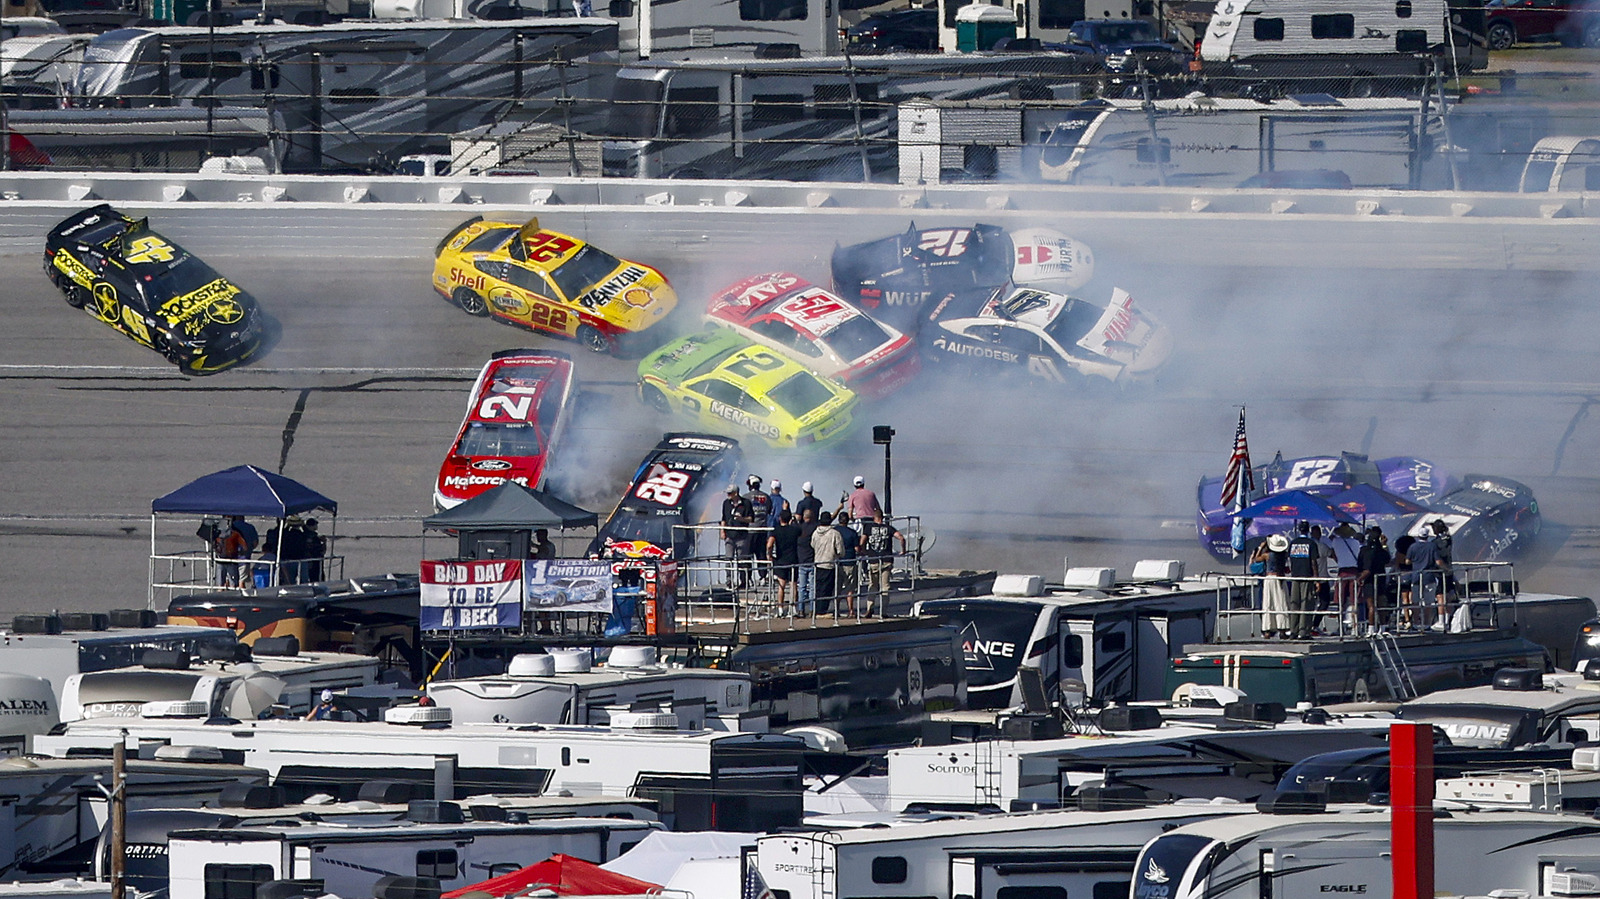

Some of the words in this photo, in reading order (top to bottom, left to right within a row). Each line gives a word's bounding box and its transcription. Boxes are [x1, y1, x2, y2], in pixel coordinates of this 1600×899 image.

[450, 267, 486, 290] Shell
[531, 303, 567, 330] 22
[782, 292, 844, 320] 54
[122, 304, 151, 343] 45
[948, 340, 1020, 365] AUTODESK
[723, 352, 784, 379] 2
[479, 386, 536, 420] 21
[682, 396, 701, 416] 2
[710, 400, 780, 440] MENARDS
[443, 473, 530, 488] Motorcrft
[1285, 460, 1340, 489] 23
[434, 563, 467, 583] BAD
[474, 562, 505, 582] DAY
[530, 561, 548, 585] 1
[548, 565, 610, 577] CHASTAIN
[447, 587, 467, 605] TO
[474, 586, 494, 604] BE
[442, 611, 454, 627] A
[0, 700, 49, 710] ALEM
[1320, 884, 1367, 893] EAGLE
